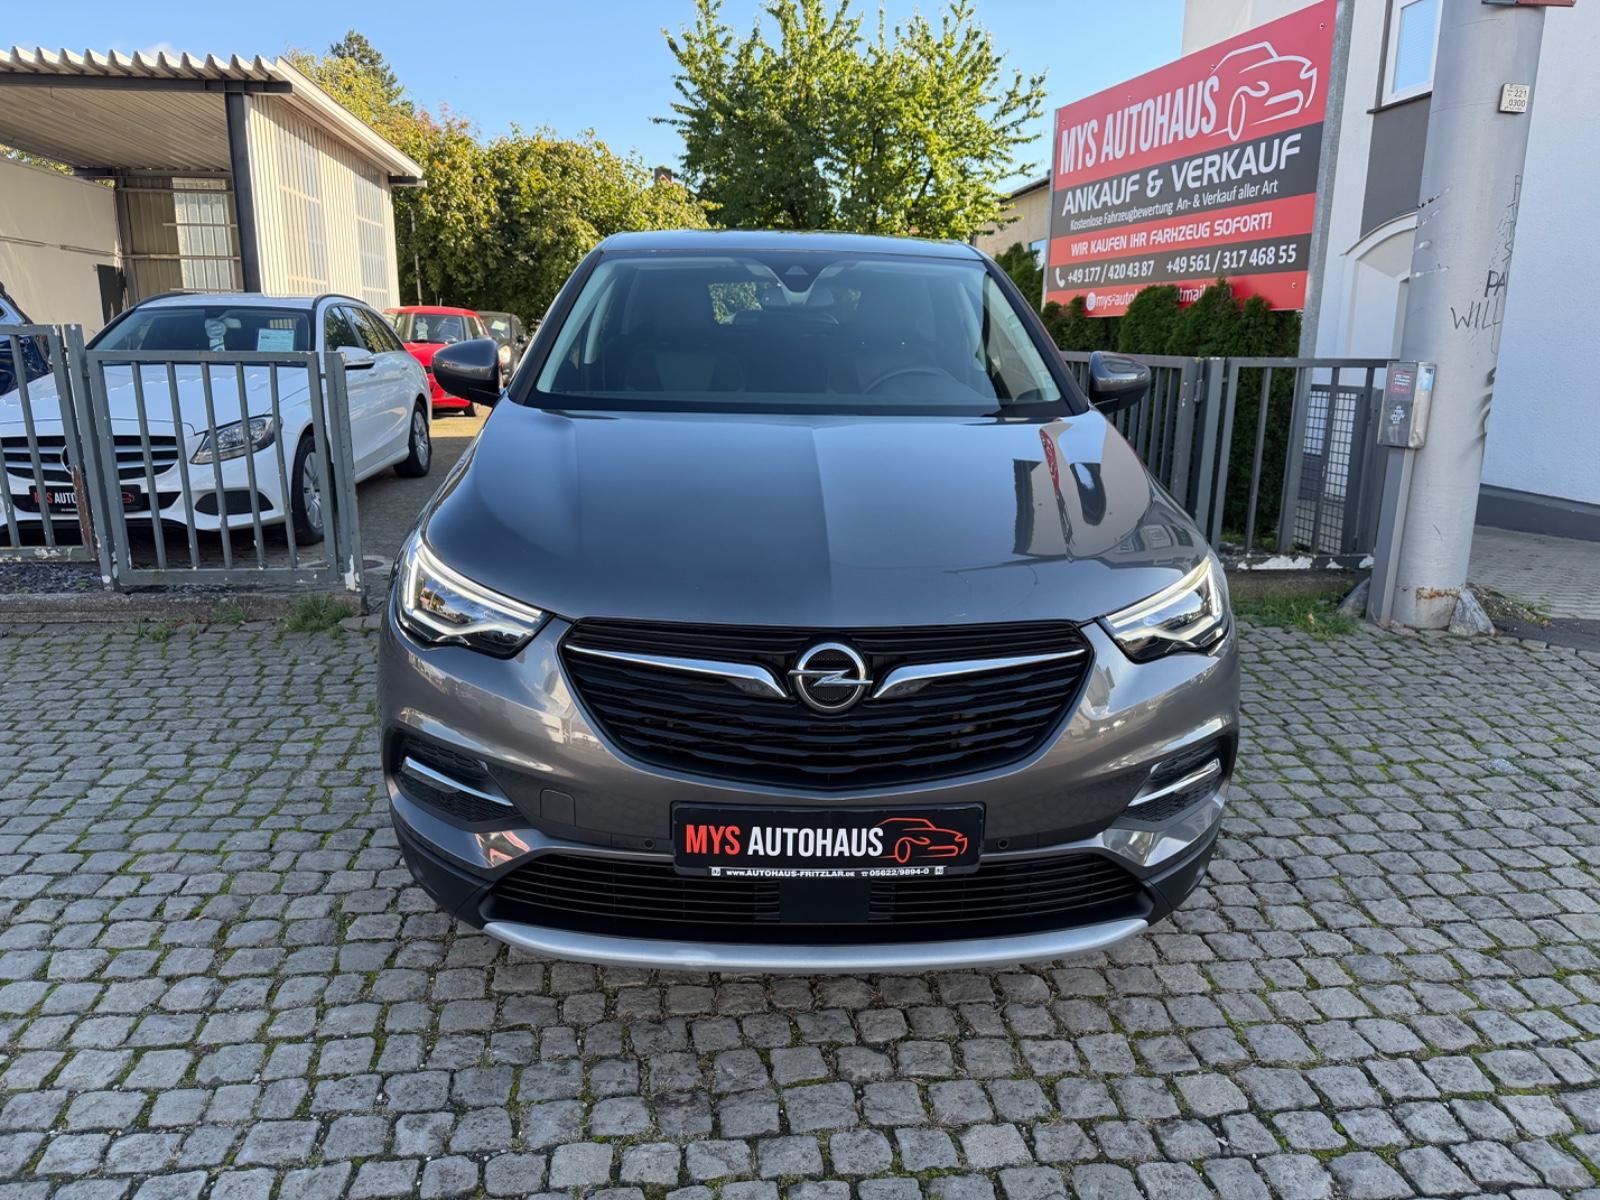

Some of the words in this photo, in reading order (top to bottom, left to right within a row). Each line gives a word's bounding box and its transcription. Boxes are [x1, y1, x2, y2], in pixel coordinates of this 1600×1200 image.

[1060, 119, 1098, 175] MYS
[1100, 75, 1219, 163] AUTOHAUS
[1061, 174, 1140, 216] ANKAUF
[1146, 169, 1163, 198] &
[1171, 133, 1302, 192] VERKAUF
[1070, 214, 1103, 231] Kostenlose
[1103, 202, 1174, 224] Fahrzeugbewertung
[1176, 197, 1191, 211] An-
[1192, 194, 1200, 208] &
[1202, 185, 1237, 206] Verkauf
[1237, 182, 1260, 199] aller
[1261, 179, 1278, 195] Art
[1071, 241, 1088, 257] WIR
[1090, 235, 1127, 254] KAUFEN
[1129, 231, 1147, 248] IHR
[1149, 221, 1211, 245] FARHZEUG
[1213, 212, 1273, 237] SOFORT!
[1067, 268, 1083, 284] +49
[1084, 266, 1101, 283] 177
[1107, 263, 1126, 280] 420
[1127, 261, 1140, 278] 43
[1141, 260, 1155, 277] 87
[1166, 256, 1188, 273] +49
[1188, 253, 1211, 272] 561
[1222, 248, 1248, 270] 317
[1249, 246, 1276, 267] 468
[1278, 243, 1297, 264] 55
[33, 492, 54, 504] MS
[685, 824, 741, 855] MYS
[747, 826, 884, 857] AUTOHAUS
